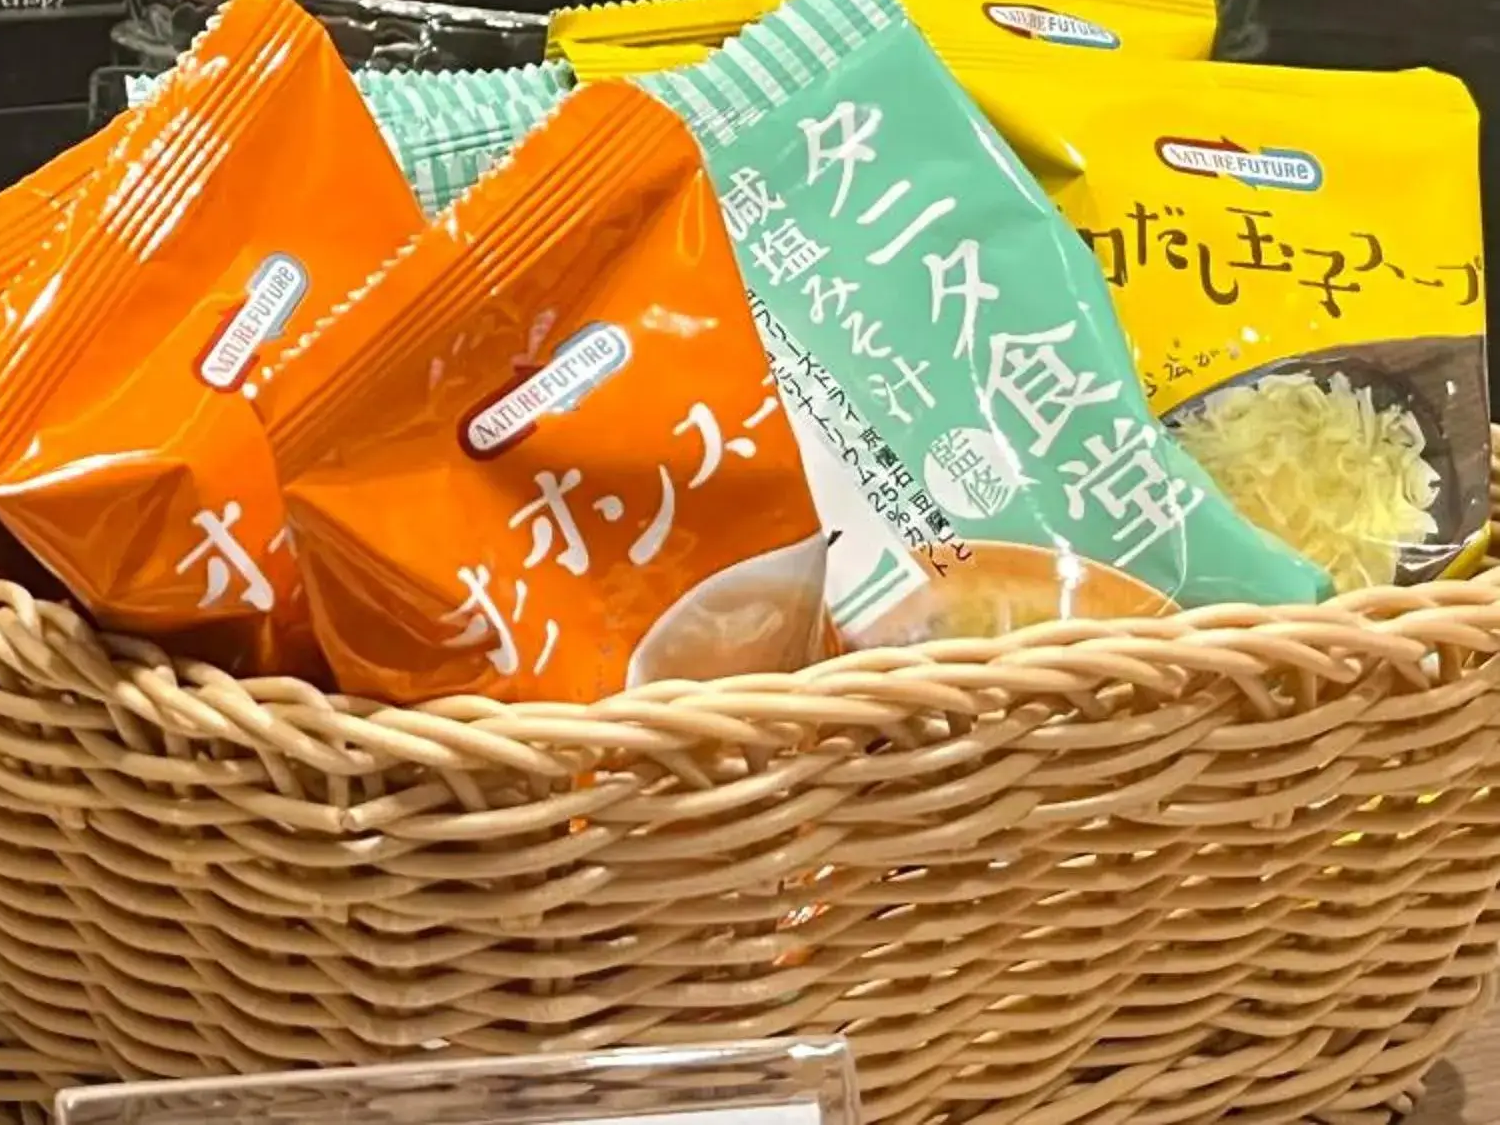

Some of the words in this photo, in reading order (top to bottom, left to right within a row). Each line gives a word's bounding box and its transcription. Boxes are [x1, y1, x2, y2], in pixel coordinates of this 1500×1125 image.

[720, 166, 937, 425] 減塩みそ汁
[796, 101, 1206, 567] タニタ食堂
[441, 377, 782, 675] オニオンスー
